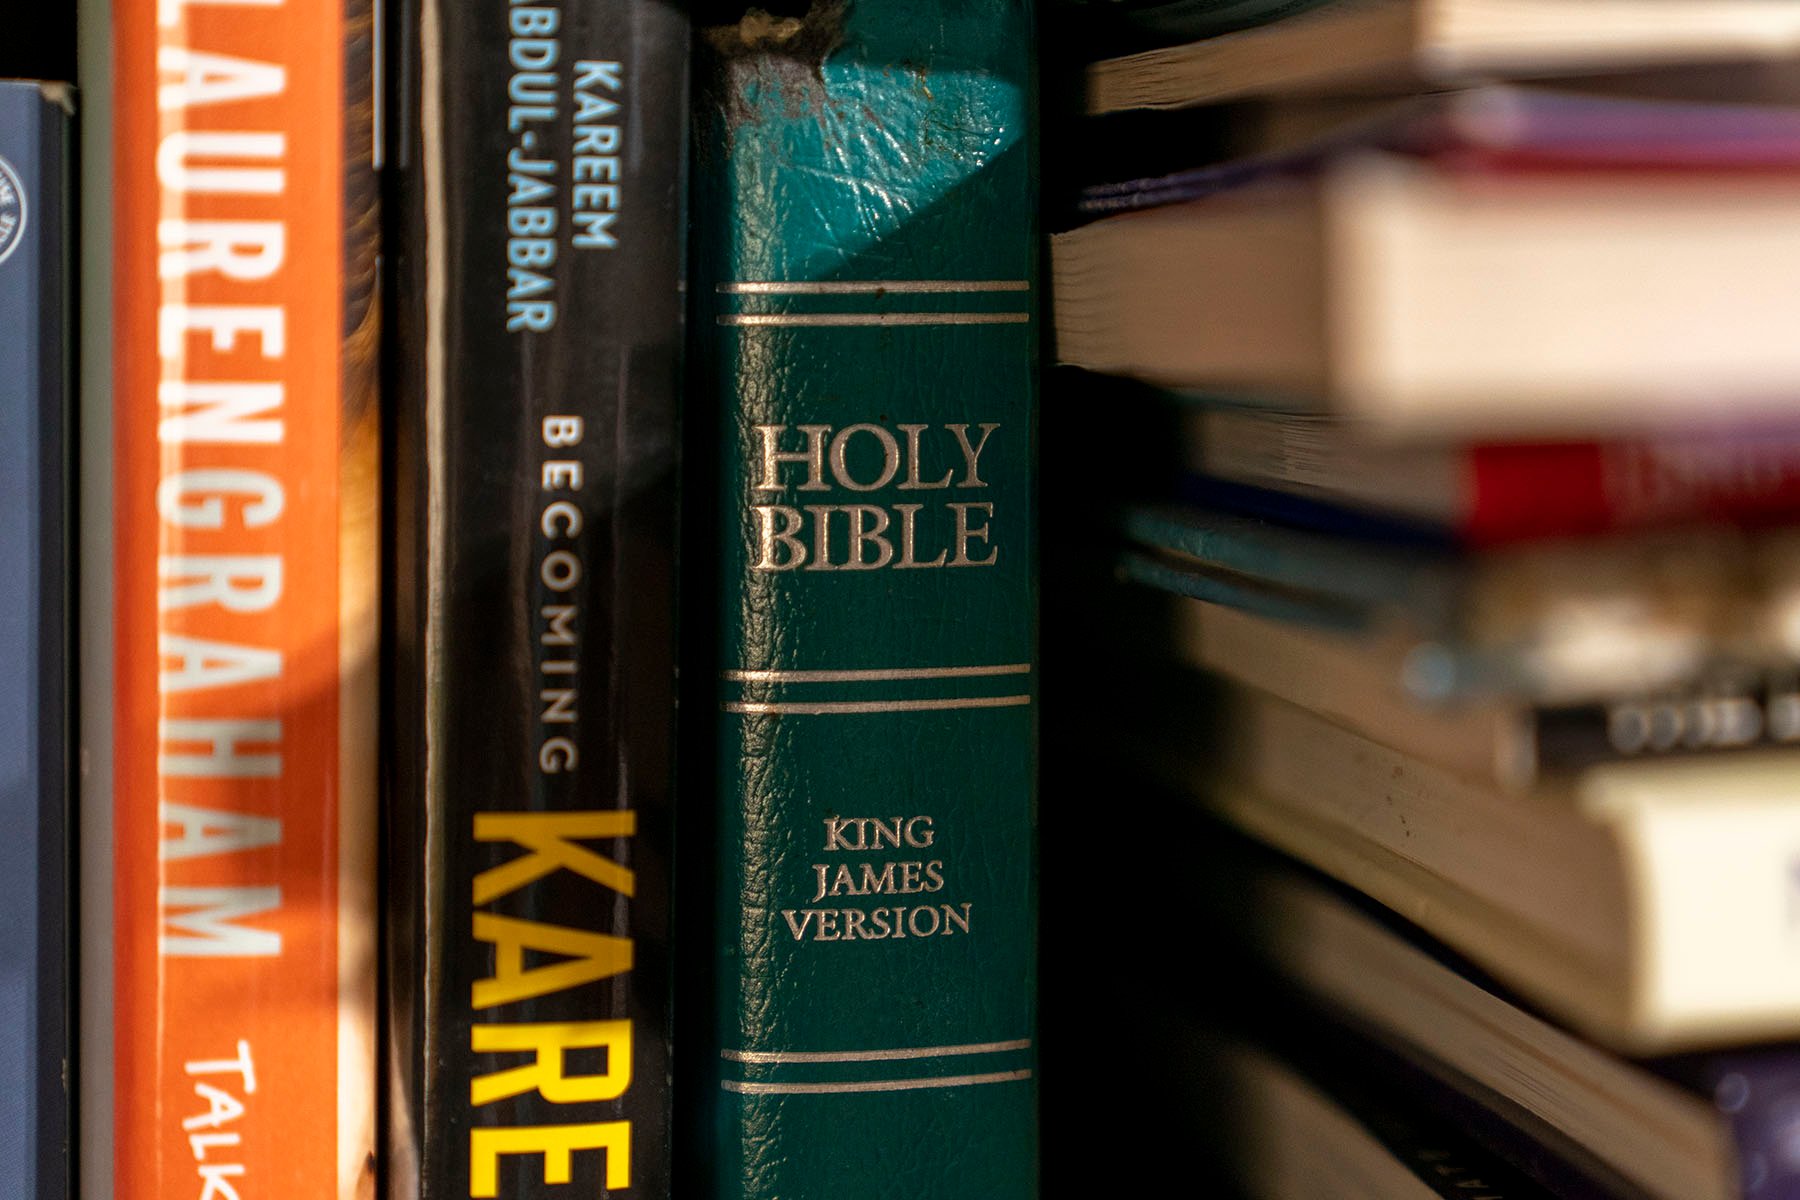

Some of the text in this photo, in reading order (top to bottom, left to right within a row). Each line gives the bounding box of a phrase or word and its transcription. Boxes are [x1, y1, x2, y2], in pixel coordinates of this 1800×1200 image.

[506, 0, 560, 333] BDUL-JABBAR
[572, 59, 623, 249] KAREEM
[752, 422, 1000, 491] HOLY
[752, 502, 998, 573] BIBLE
[539, 415, 583, 774] BECOMING
[823, 815, 935, 851] KING
[812, 859, 945, 904] JAMES
[781, 902, 973, 941] VERSION
[470, 809, 637, 1199] KARE
